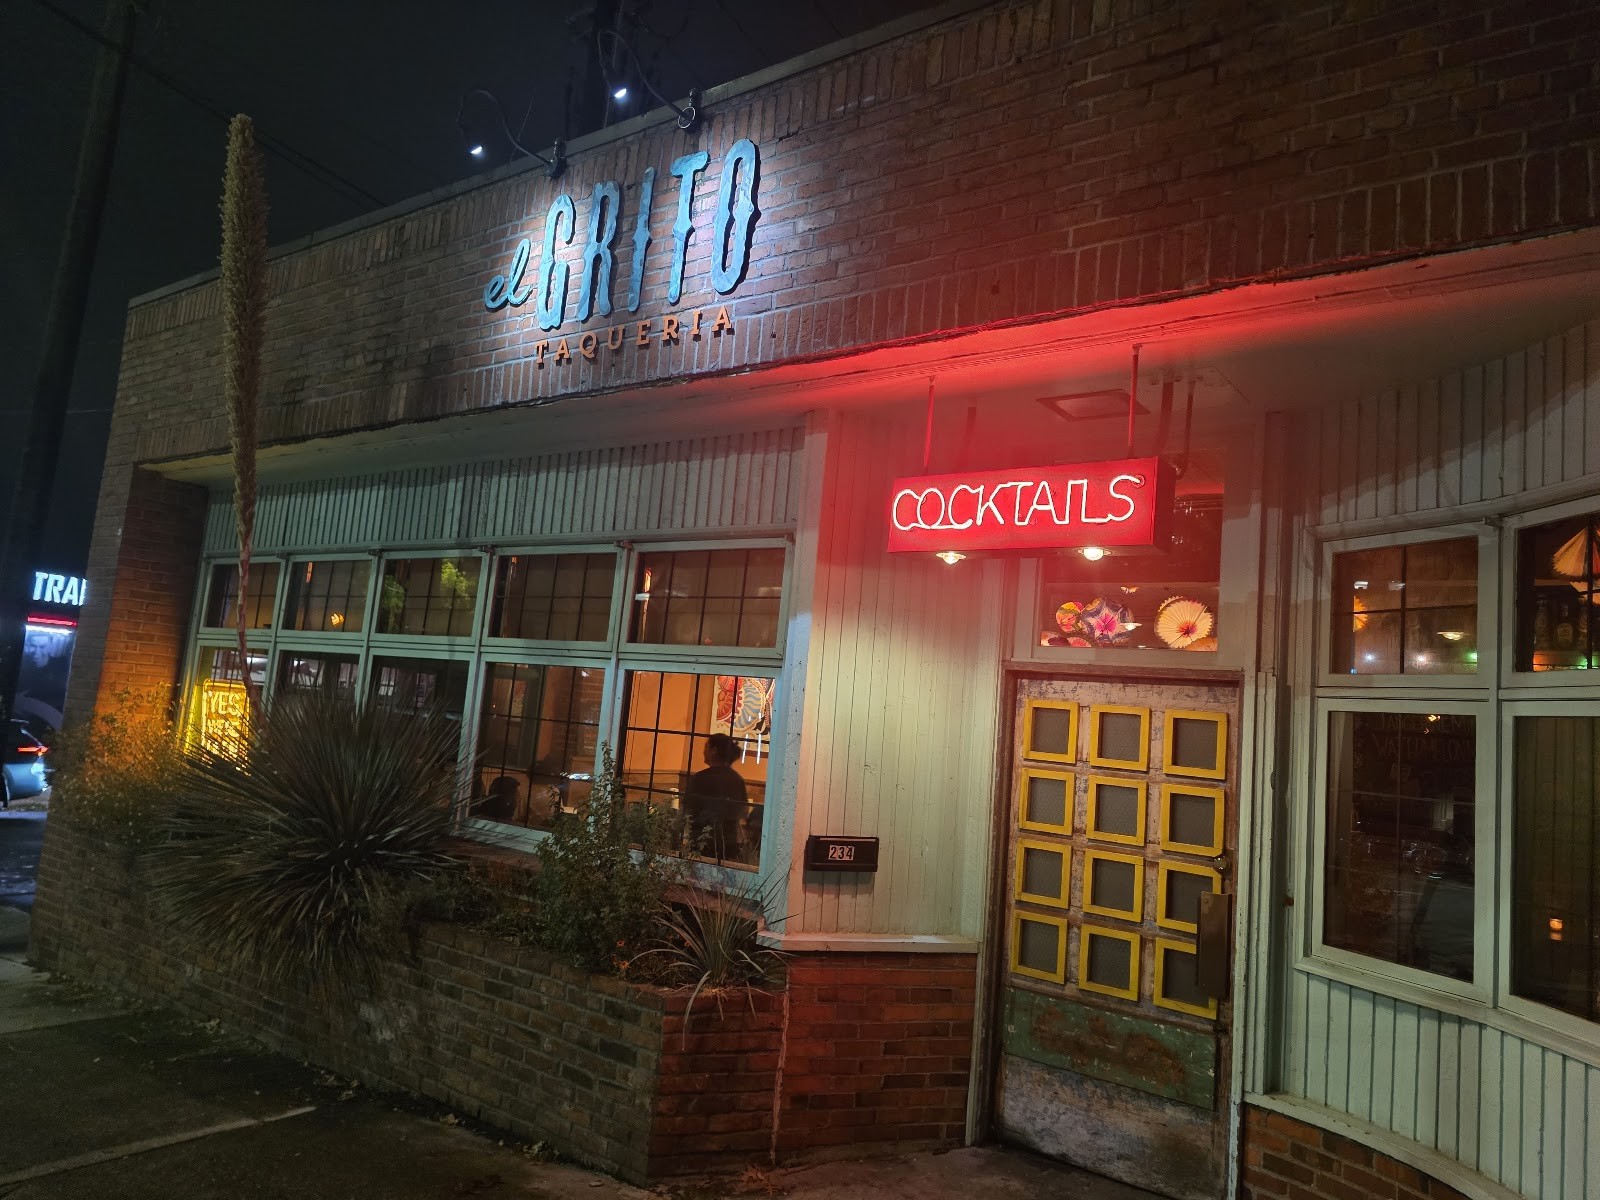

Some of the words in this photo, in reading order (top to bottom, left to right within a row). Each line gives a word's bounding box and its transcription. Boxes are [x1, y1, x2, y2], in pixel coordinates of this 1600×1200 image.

[484, 238, 533, 309] el
[536, 138, 759, 331] GRITO
[535, 305, 732, 364] TAQUERIA
[893, 474, 1143, 531] COCKTAILS
[829, 846, 853, 860] 234
